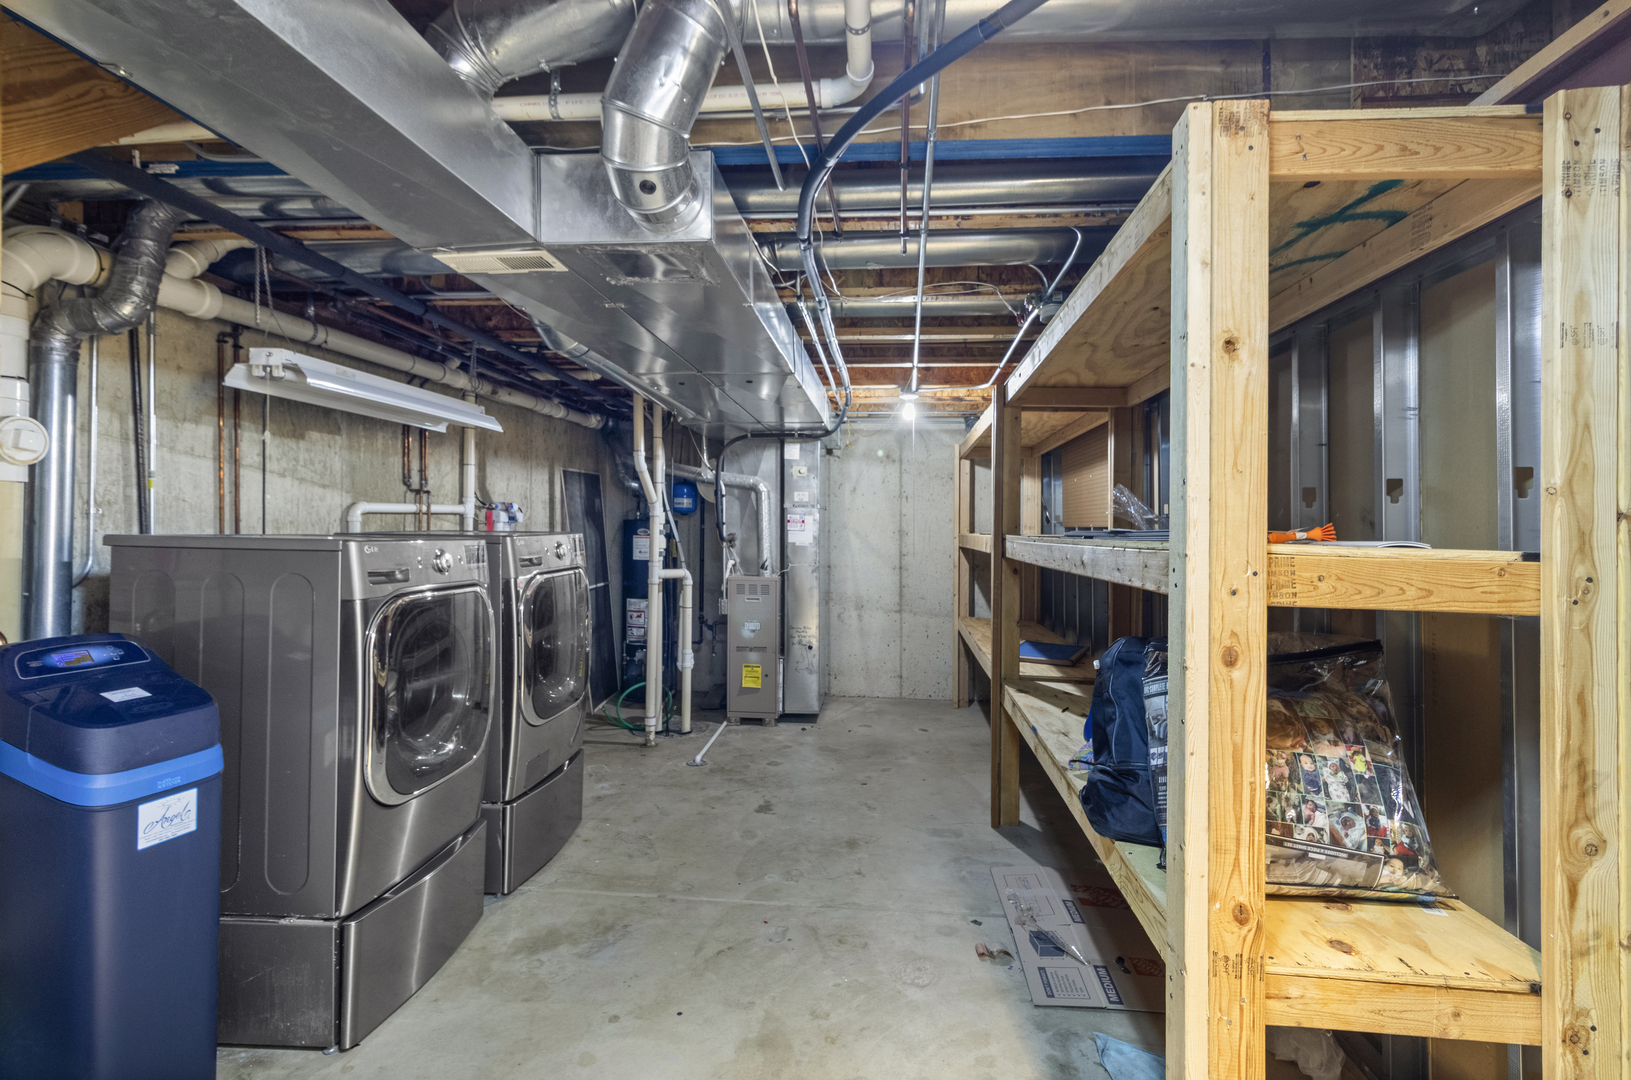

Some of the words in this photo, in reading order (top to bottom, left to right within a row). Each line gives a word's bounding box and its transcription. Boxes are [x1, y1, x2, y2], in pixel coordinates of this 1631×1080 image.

[1584, 160, 1596, 186] PRIME
[1269, 557, 1295, 568] PRIME
[1065, 902, 1082, 922] MEDIUM
[1097, 967, 1119, 1002] MEDIUM
